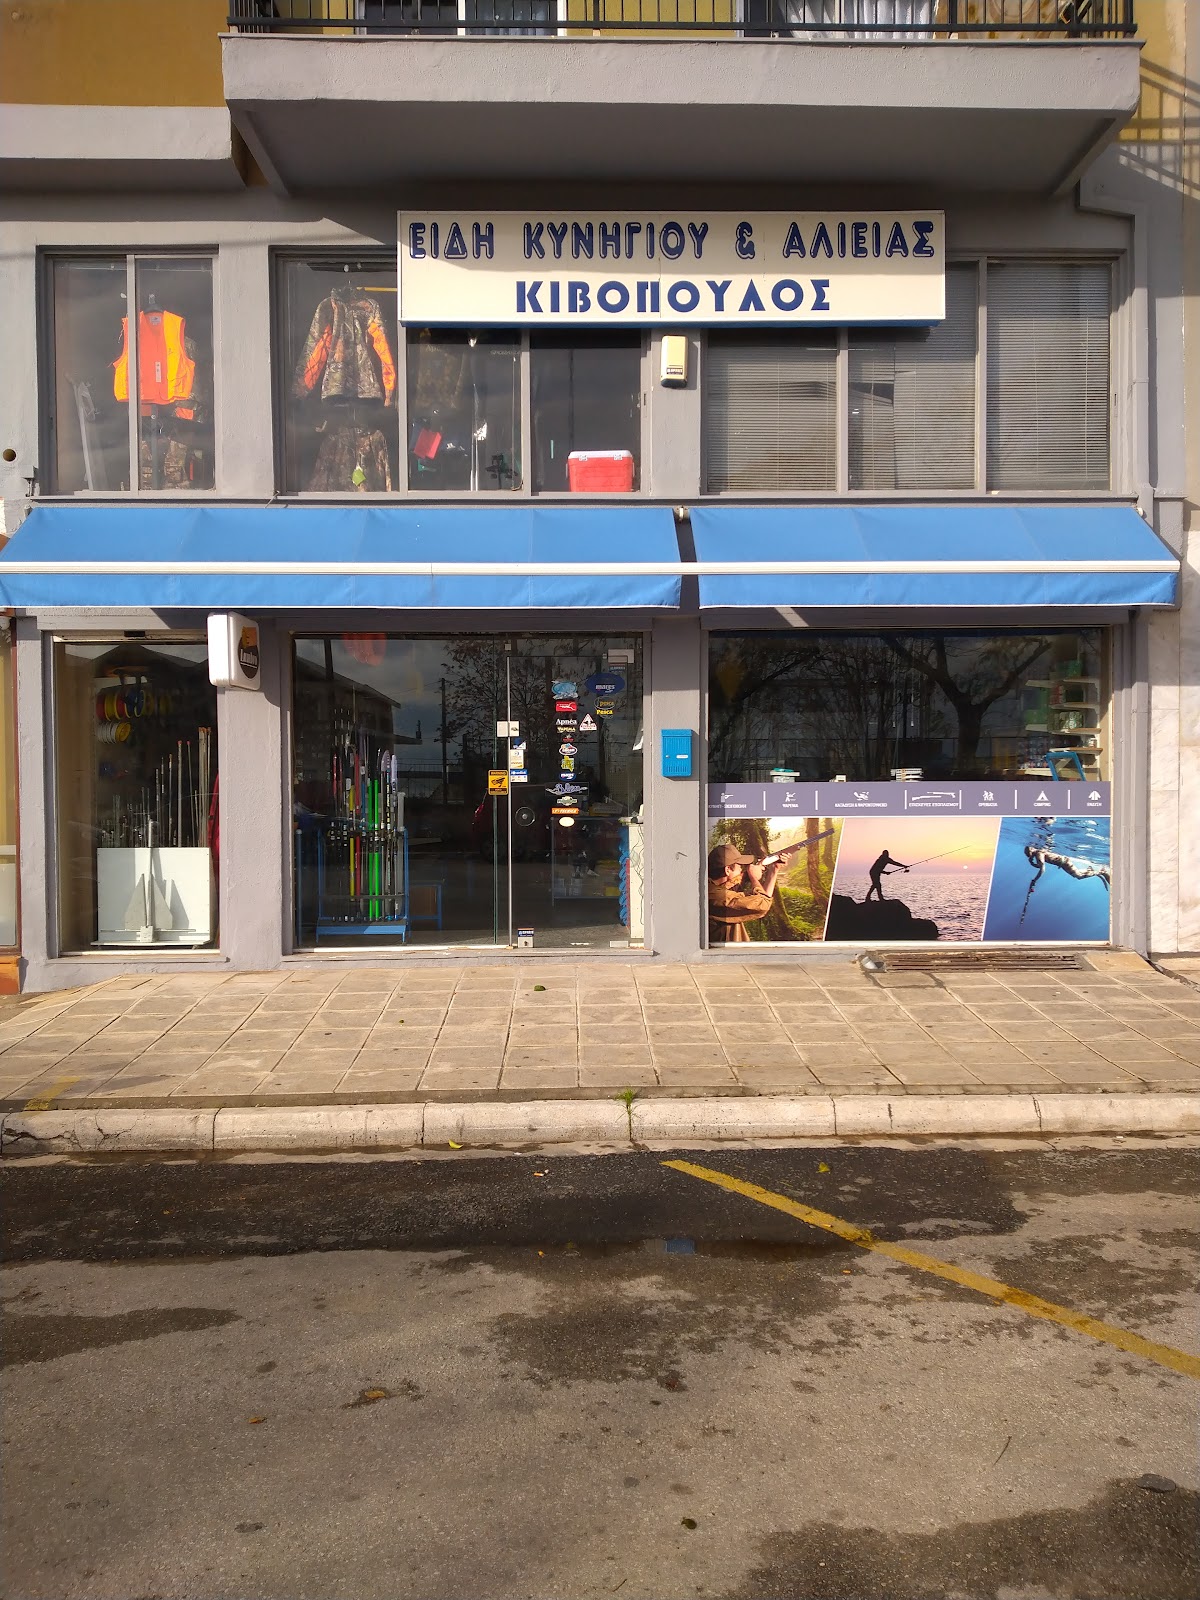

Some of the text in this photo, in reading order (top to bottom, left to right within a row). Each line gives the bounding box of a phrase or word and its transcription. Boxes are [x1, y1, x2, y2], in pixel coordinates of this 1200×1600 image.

[408, 220, 936, 261] ΕΙΔΗ ΚΥΝΗΓΙΟΥ & ΑΛΙΕΙΑΣ
[516, 278, 831, 314] ΚΙΒΟΠΟΥΛΟΣ
